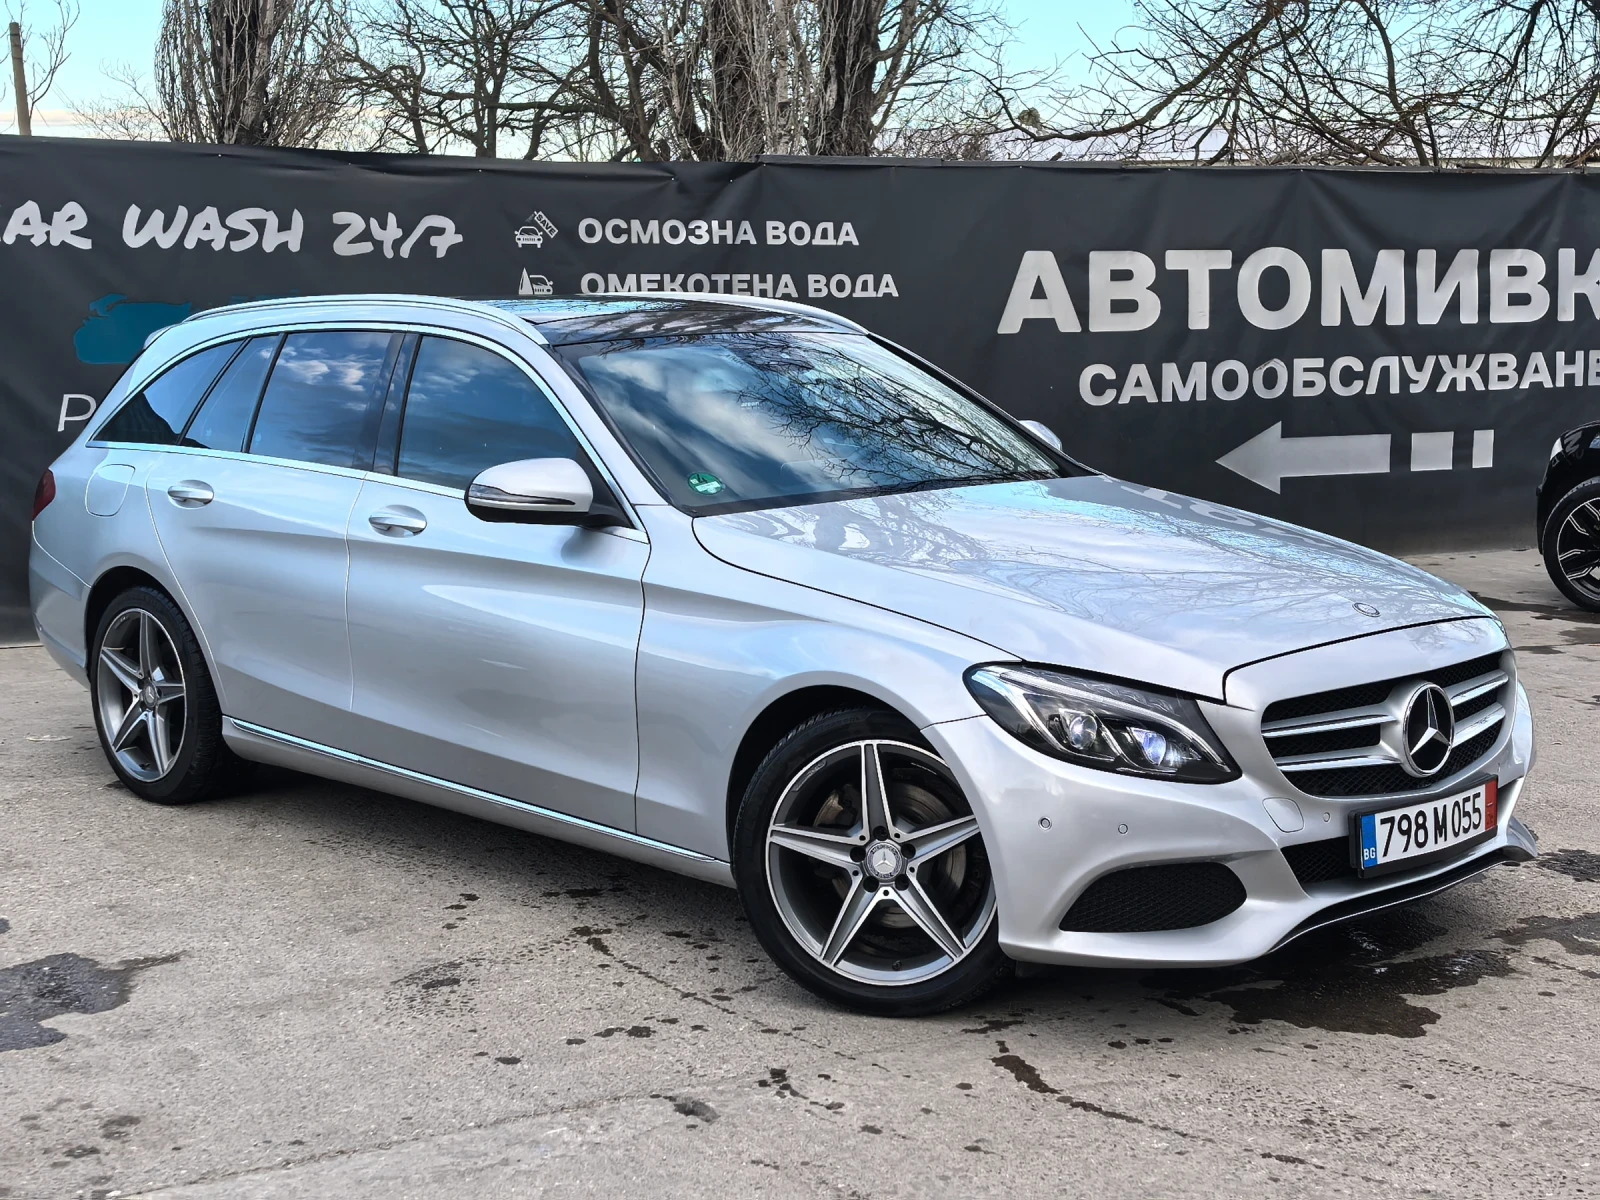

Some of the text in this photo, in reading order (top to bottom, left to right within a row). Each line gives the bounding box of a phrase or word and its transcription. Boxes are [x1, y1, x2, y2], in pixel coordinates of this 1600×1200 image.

[0, 200, 463, 258] AR WASH 24/7
[537, 214, 556, 236] SAVE
[579, 218, 859, 246] ОСМОЗНА ВОДА
[580, 272, 899, 298] ОМЕКОТЕНА ВОДА
[1379, 791, 1482, 858] 798 M 055
[1363, 848, 1376, 861] BG
